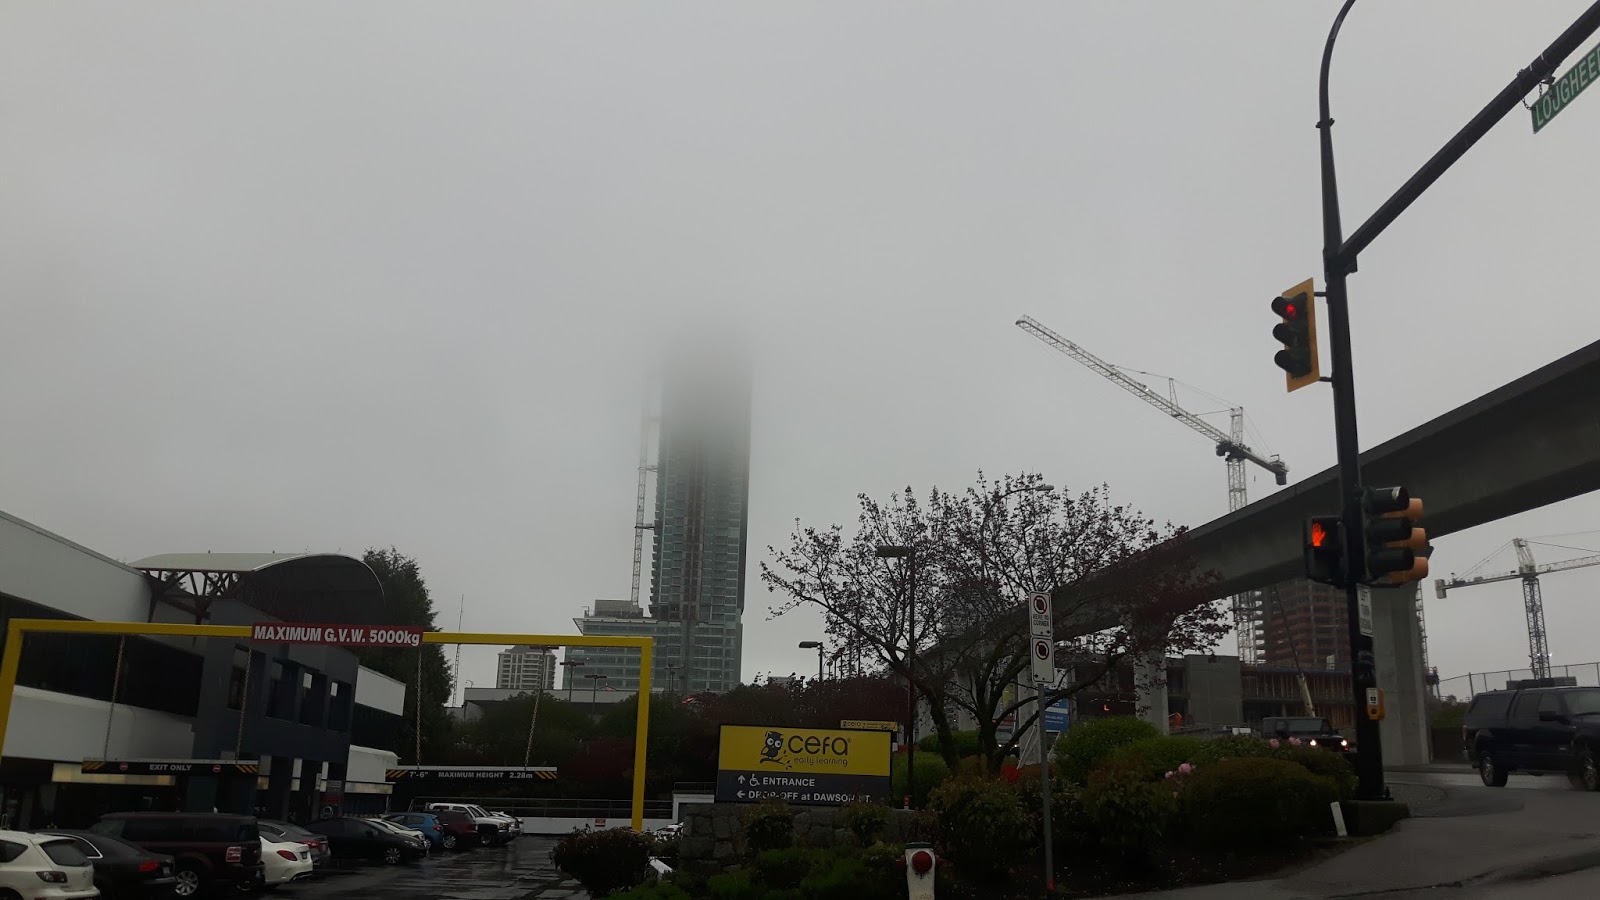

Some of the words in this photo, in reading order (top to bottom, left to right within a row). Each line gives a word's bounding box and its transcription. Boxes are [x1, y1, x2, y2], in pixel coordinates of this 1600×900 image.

[254, 626, 322, 641] MAXIMUM
[324, 628, 366, 643] G.V.W.
[369, 630, 420, 646] 5000kg
[788, 735, 848, 755] cefa
[794, 757, 814, 766] early
[816, 757, 848, 767] learning
[763, 777, 815, 787] ENTRANCE
[801, 793, 811, 801] at
